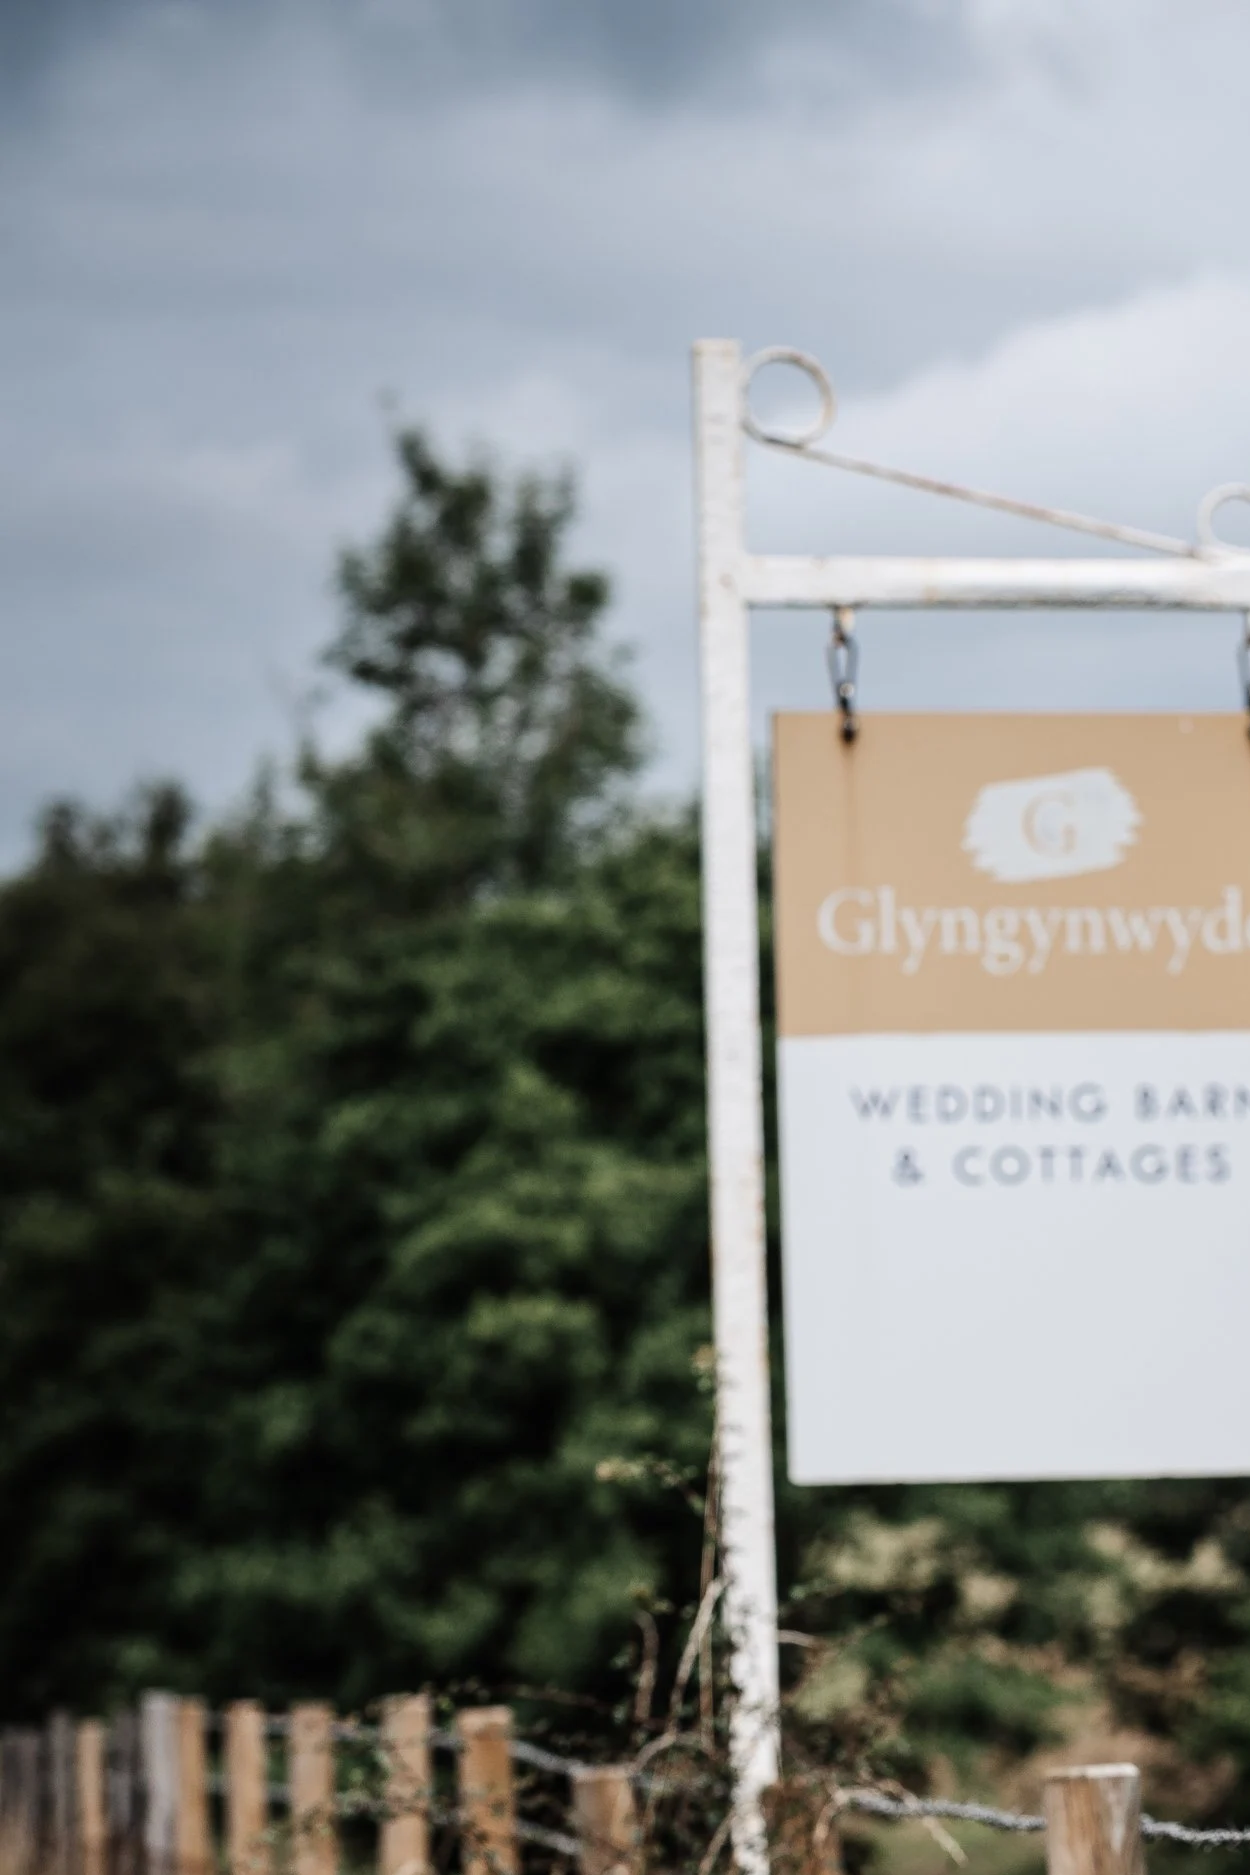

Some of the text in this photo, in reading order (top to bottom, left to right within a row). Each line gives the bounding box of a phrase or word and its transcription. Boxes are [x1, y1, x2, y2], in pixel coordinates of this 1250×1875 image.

[1021, 791, 1077, 859] G
[850, 1082, 1108, 1124] WEDDING
[891, 1143, 1232, 1187] & COTTAGES
